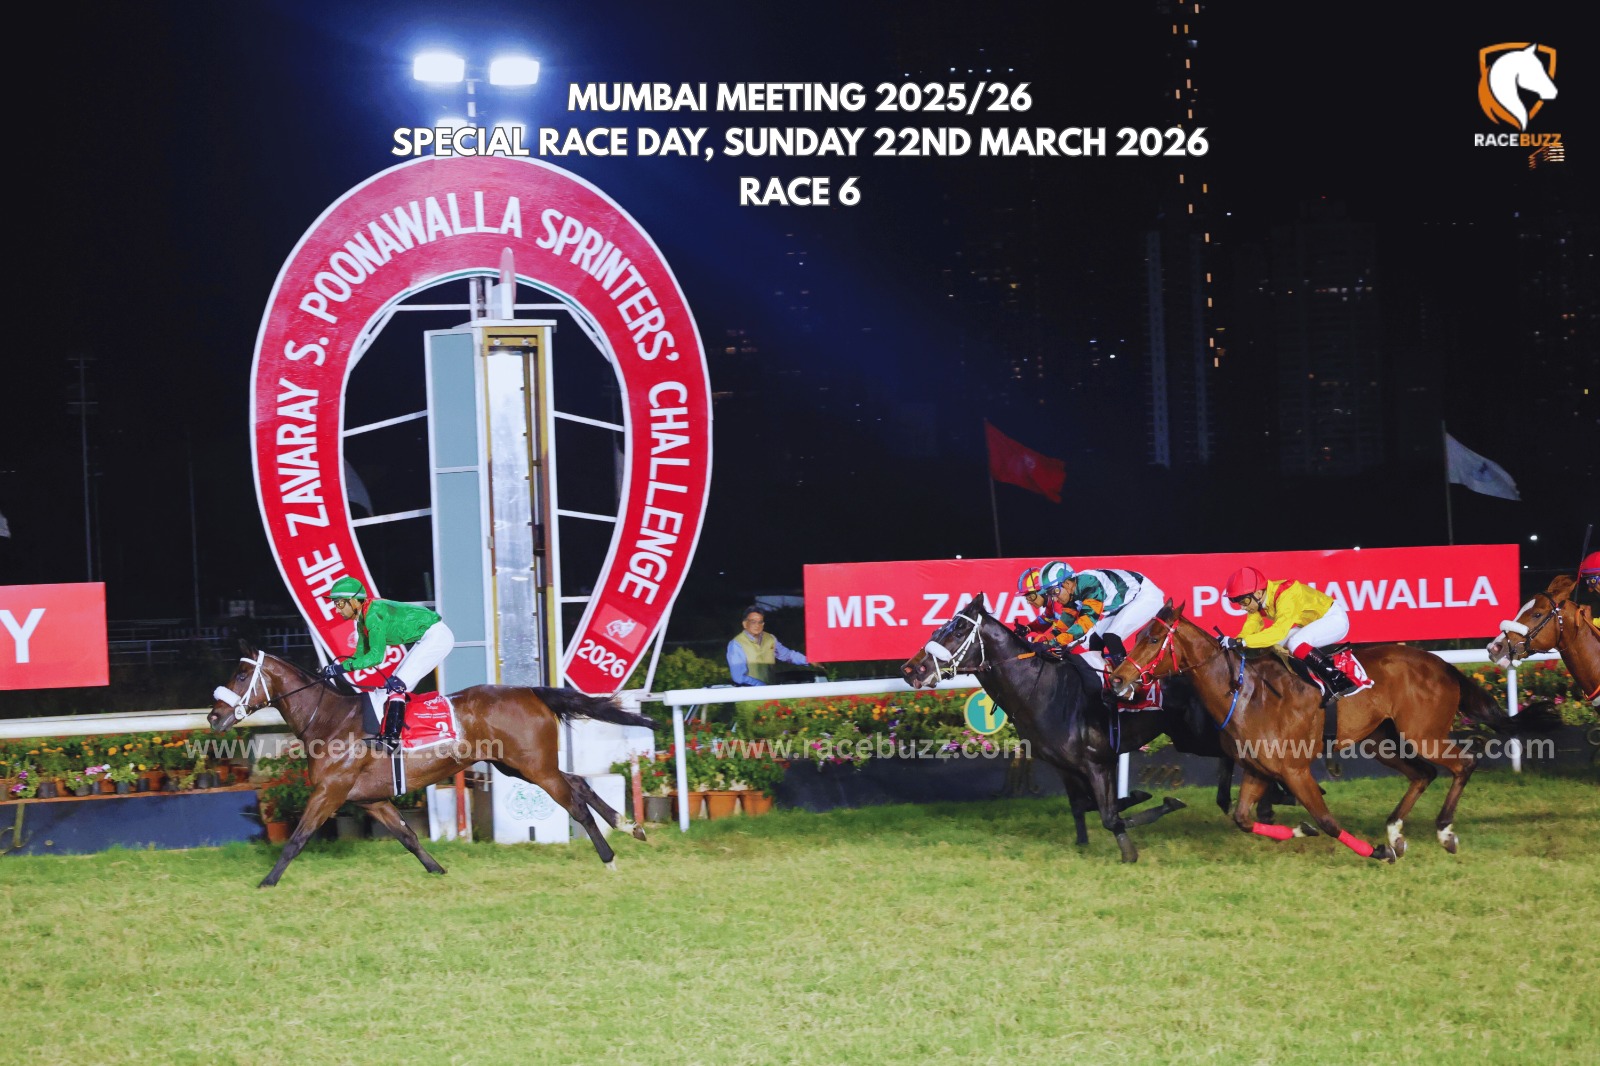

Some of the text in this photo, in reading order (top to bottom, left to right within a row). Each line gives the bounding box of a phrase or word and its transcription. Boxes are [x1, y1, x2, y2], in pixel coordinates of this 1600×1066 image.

[298, 190, 523, 325] POONAWALLA
[535, 208, 680, 361] SPRINTERS'
[283, 336, 330, 367] S.
[276, 377, 331, 538] ZAVARAY
[617, 380, 691, 605] CHALLENGE
[826, 594, 908, 629] MR.
[1192, 575, 1499, 618] POAWALLA
[576, 638, 628, 679] 2026
[435, 721, 451, 738] 2
[977, 694, 996, 730] 1
